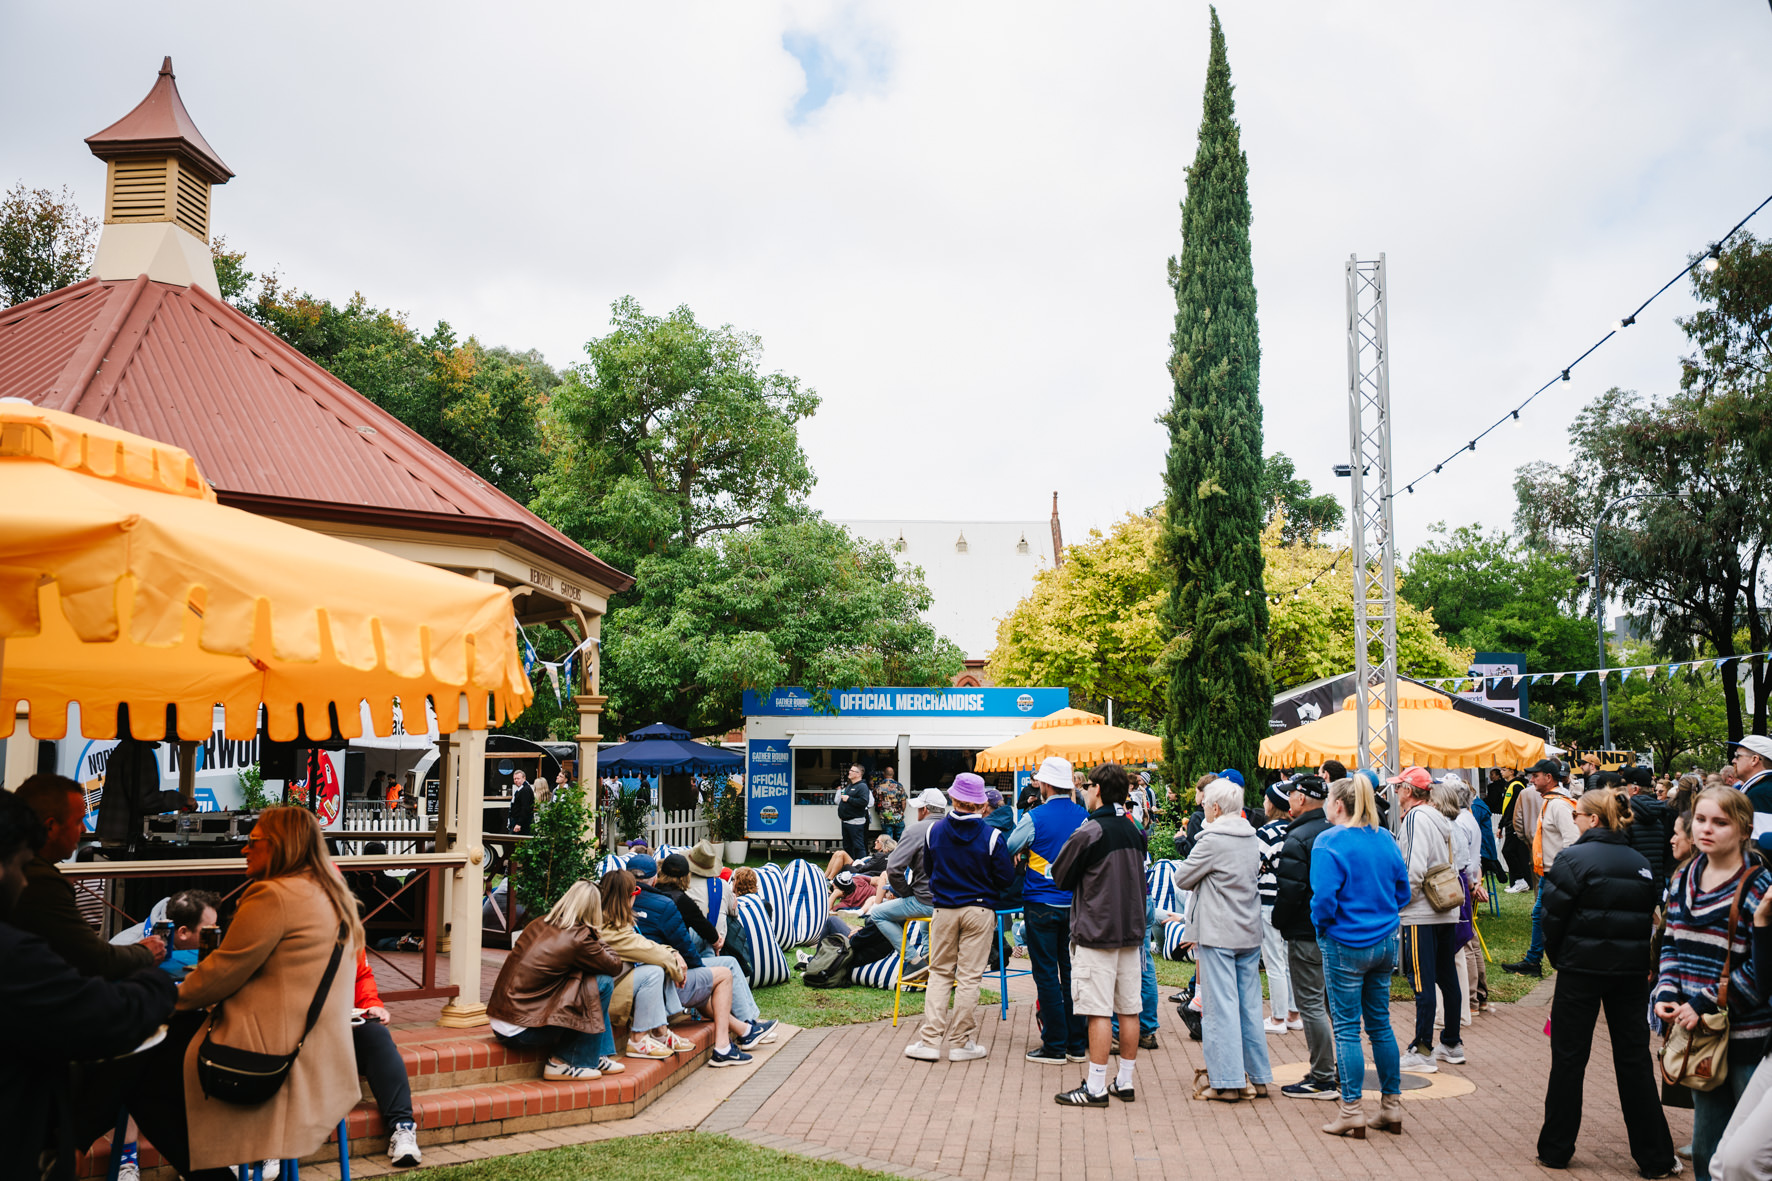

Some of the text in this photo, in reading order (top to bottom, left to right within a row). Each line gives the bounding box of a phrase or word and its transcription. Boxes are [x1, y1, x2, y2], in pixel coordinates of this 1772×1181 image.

[530, 568, 582, 601] MEMORIAL GARDENS
[840, 693, 984, 711] OFFICIAL MERCHANDISE
[752, 752, 789, 761] GATHER ROUND
[1564, 751, 1629, 768] RND
[752, 773, 788, 787] OFFICIAL
[752, 784, 788, 799] MERCH
